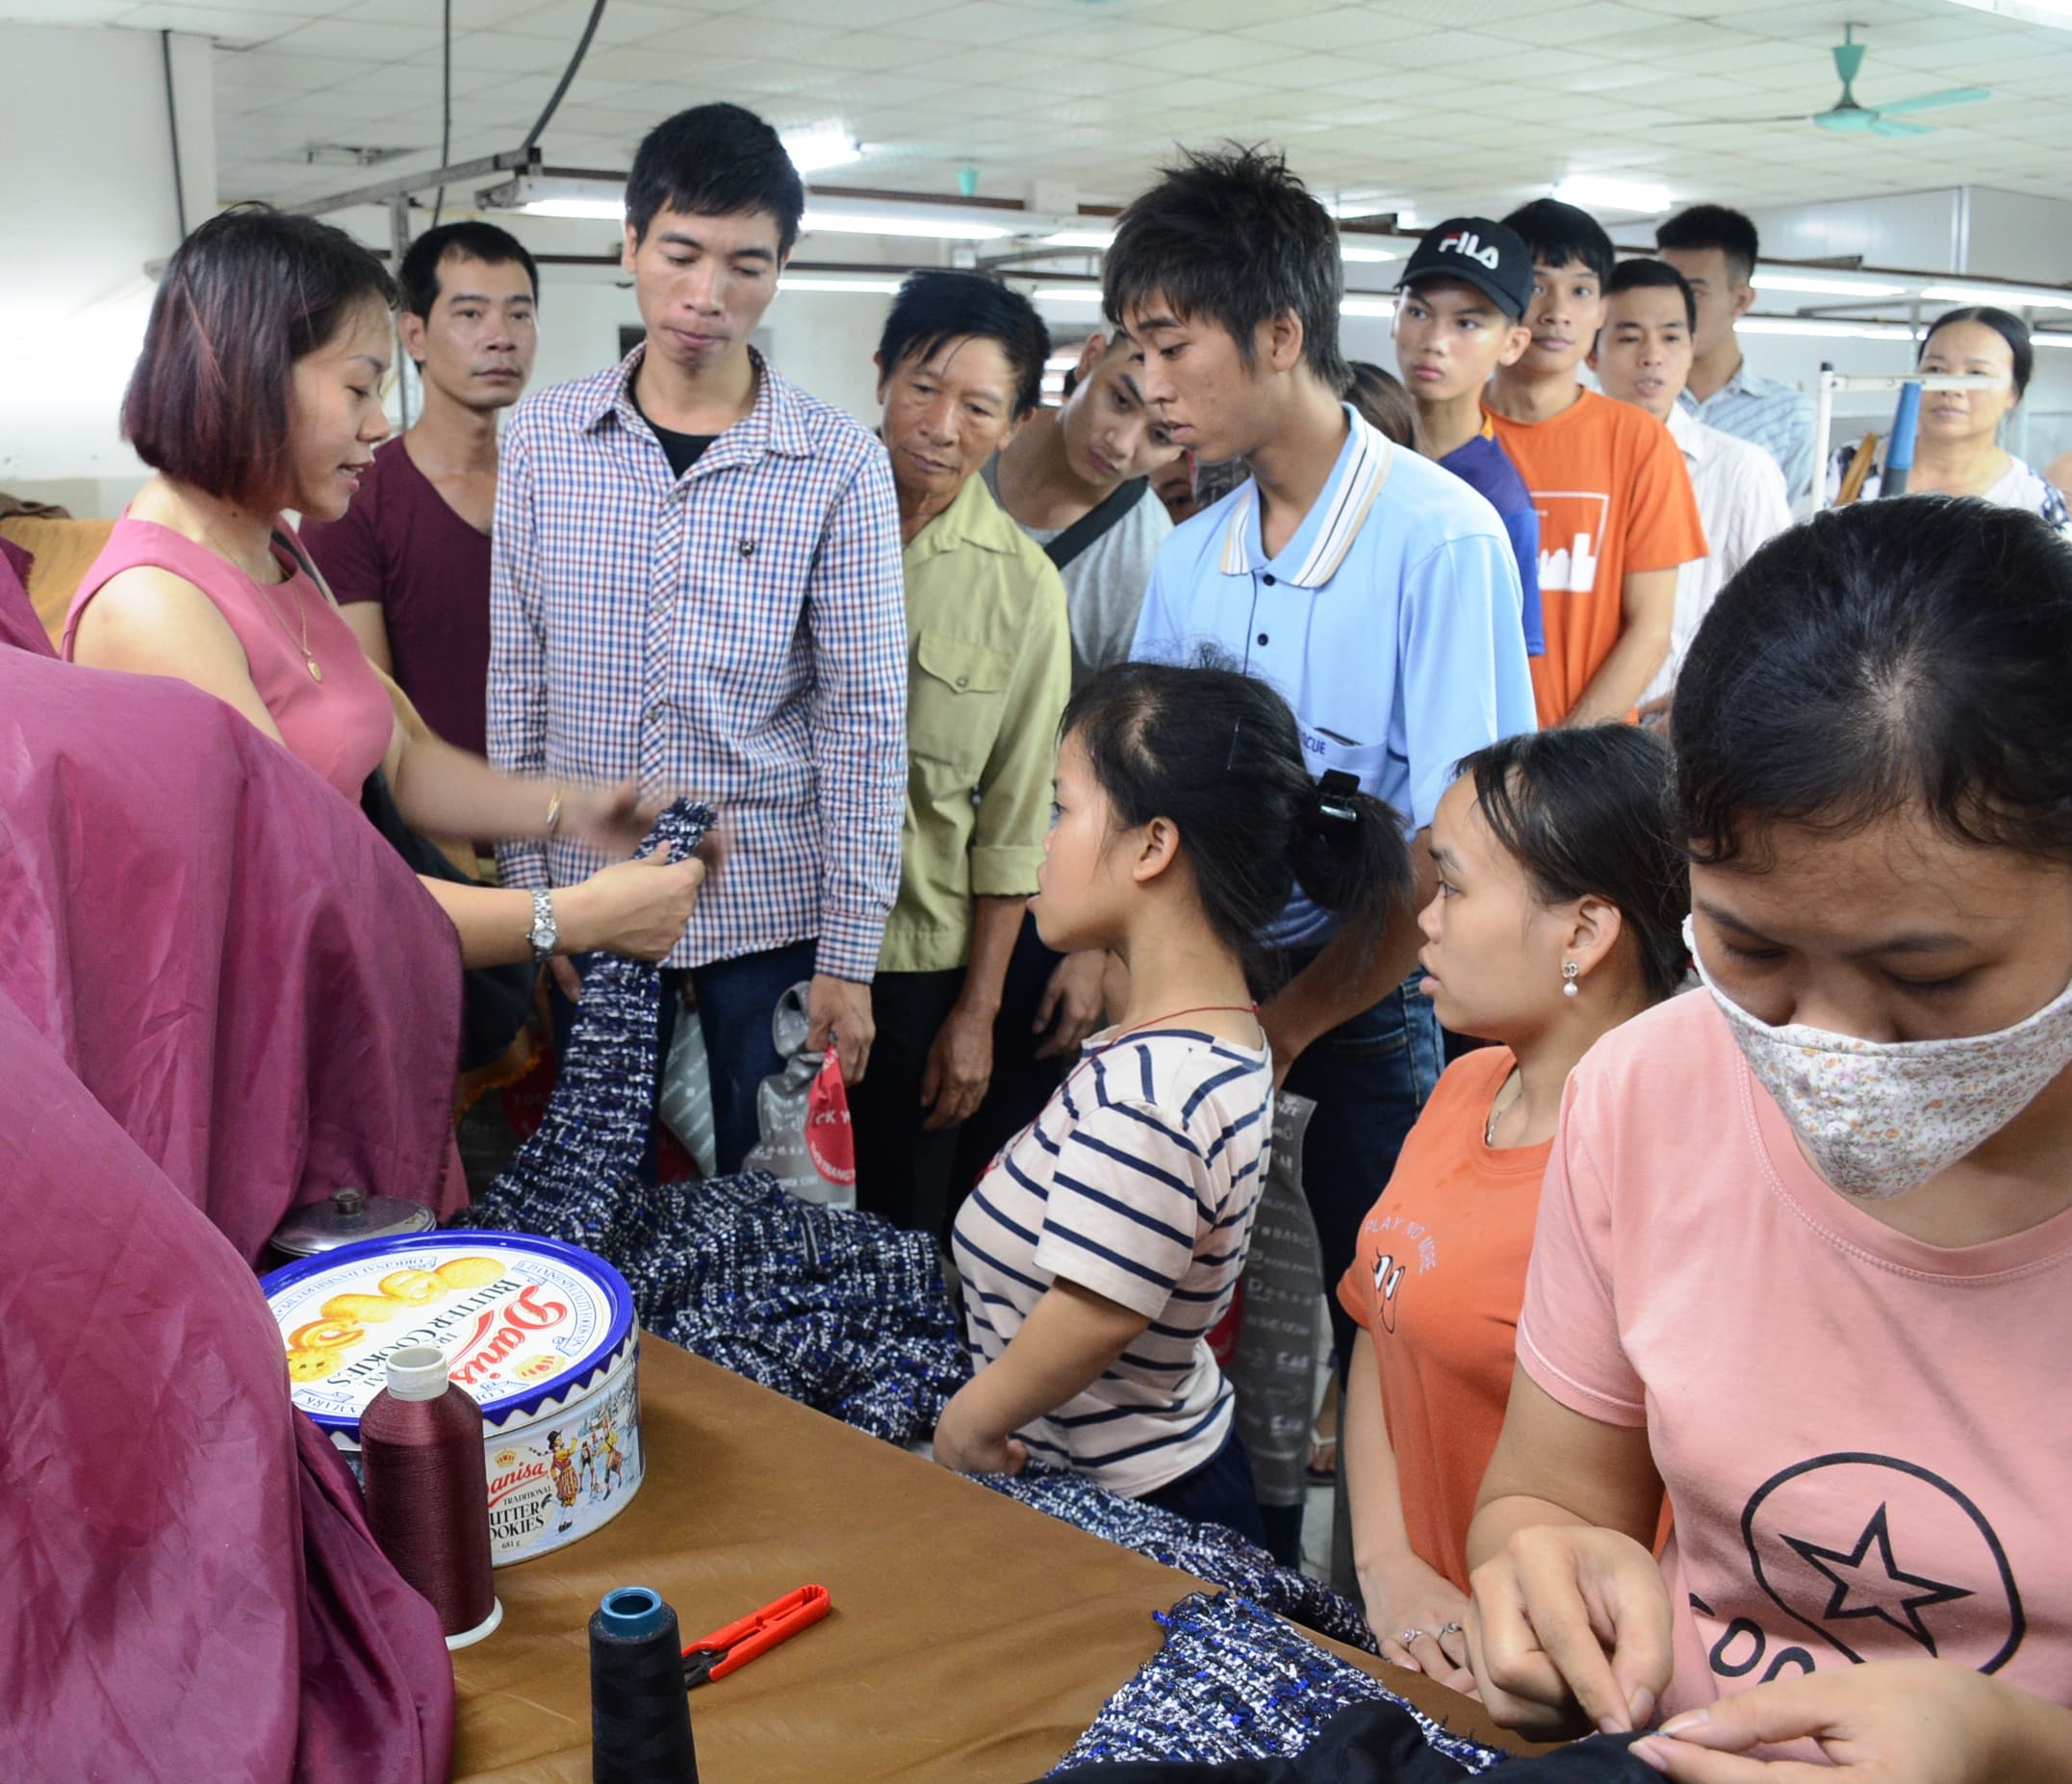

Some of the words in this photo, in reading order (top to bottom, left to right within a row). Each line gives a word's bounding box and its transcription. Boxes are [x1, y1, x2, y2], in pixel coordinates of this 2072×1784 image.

[1438, 231, 1498, 269] FILA
[426, 1279, 522, 1329] BUTTER
[448, 1284, 568, 1385] Danis
[326, 1329, 437, 1386] COOKIES
[489, 1461, 548, 1494] anisa
[503, 1485, 551, 1506] TRADITIONAL
[490, 1501, 540, 1526] UTTER
[490, 1516, 545, 1540] OOKIES
